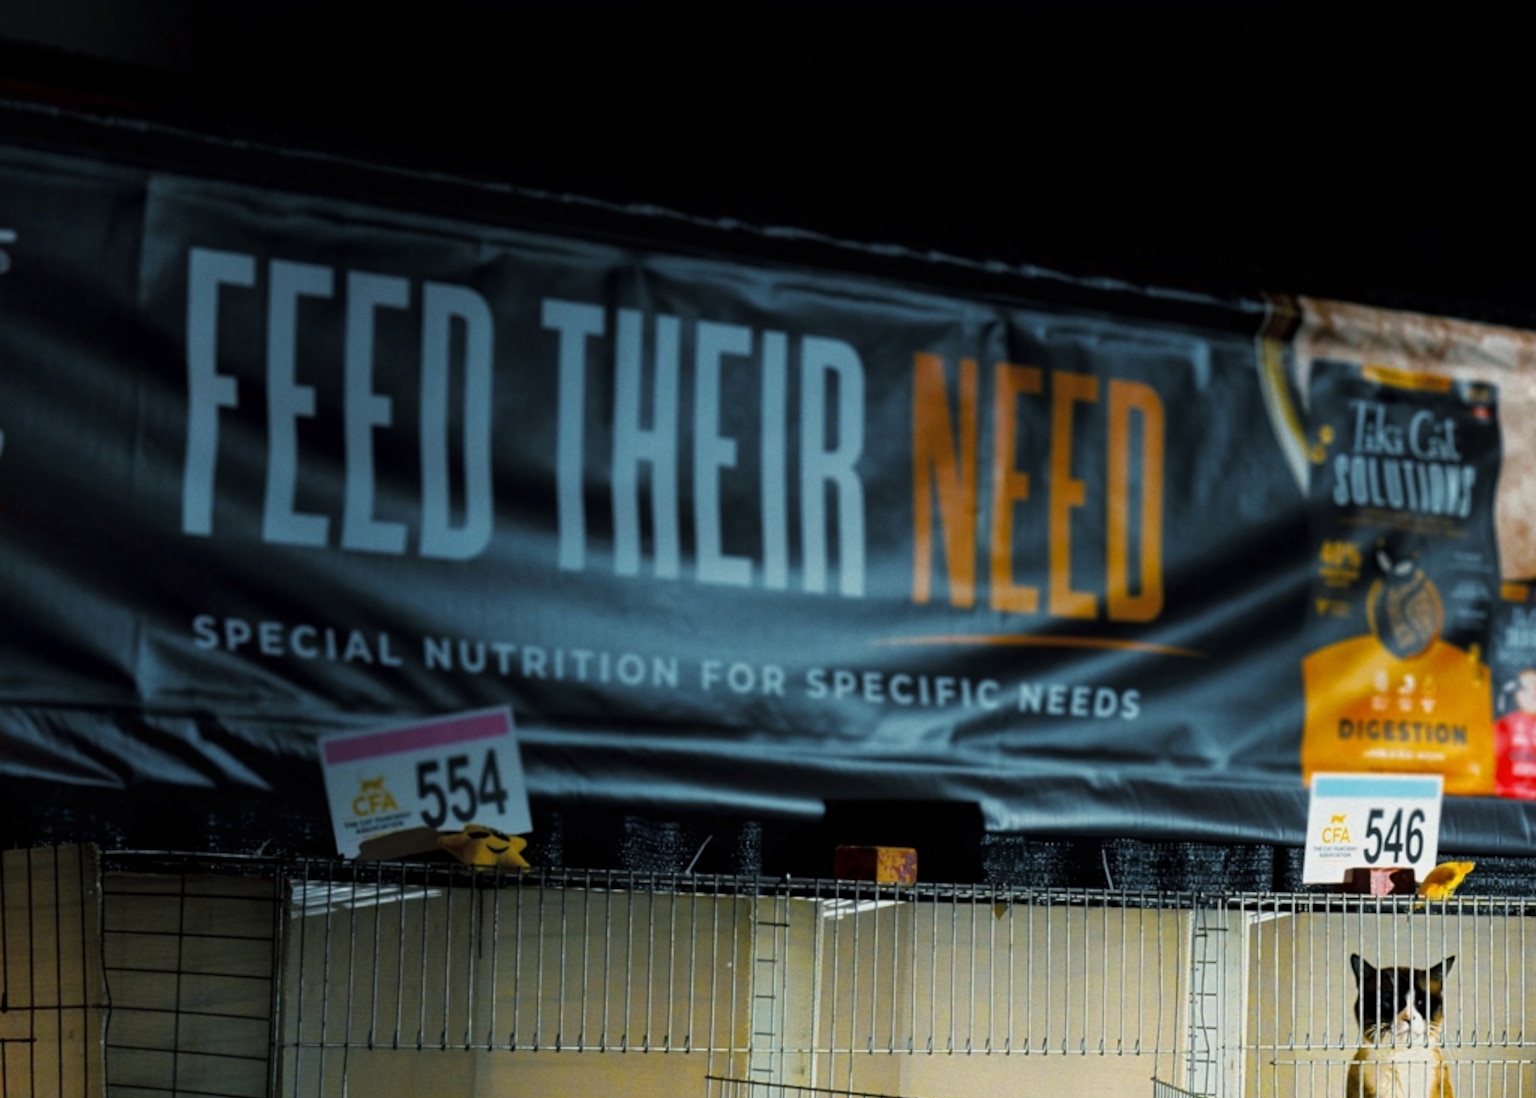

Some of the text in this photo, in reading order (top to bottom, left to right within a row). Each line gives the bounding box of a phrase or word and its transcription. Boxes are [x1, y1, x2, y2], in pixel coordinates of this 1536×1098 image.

[182, 246, 1165, 623] FEED THEIR NEED
[192, 614, 1141, 720] SPECIAL NUTRITION FOR SPECIFIC NEEDS
[1338, 718, 1468, 747] DIGESTION
[352, 790, 400, 817] CFA
[416, 747, 509, 829] 554
[1322, 827, 1352, 844] CFA
[1363, 807, 1426, 864] 546
